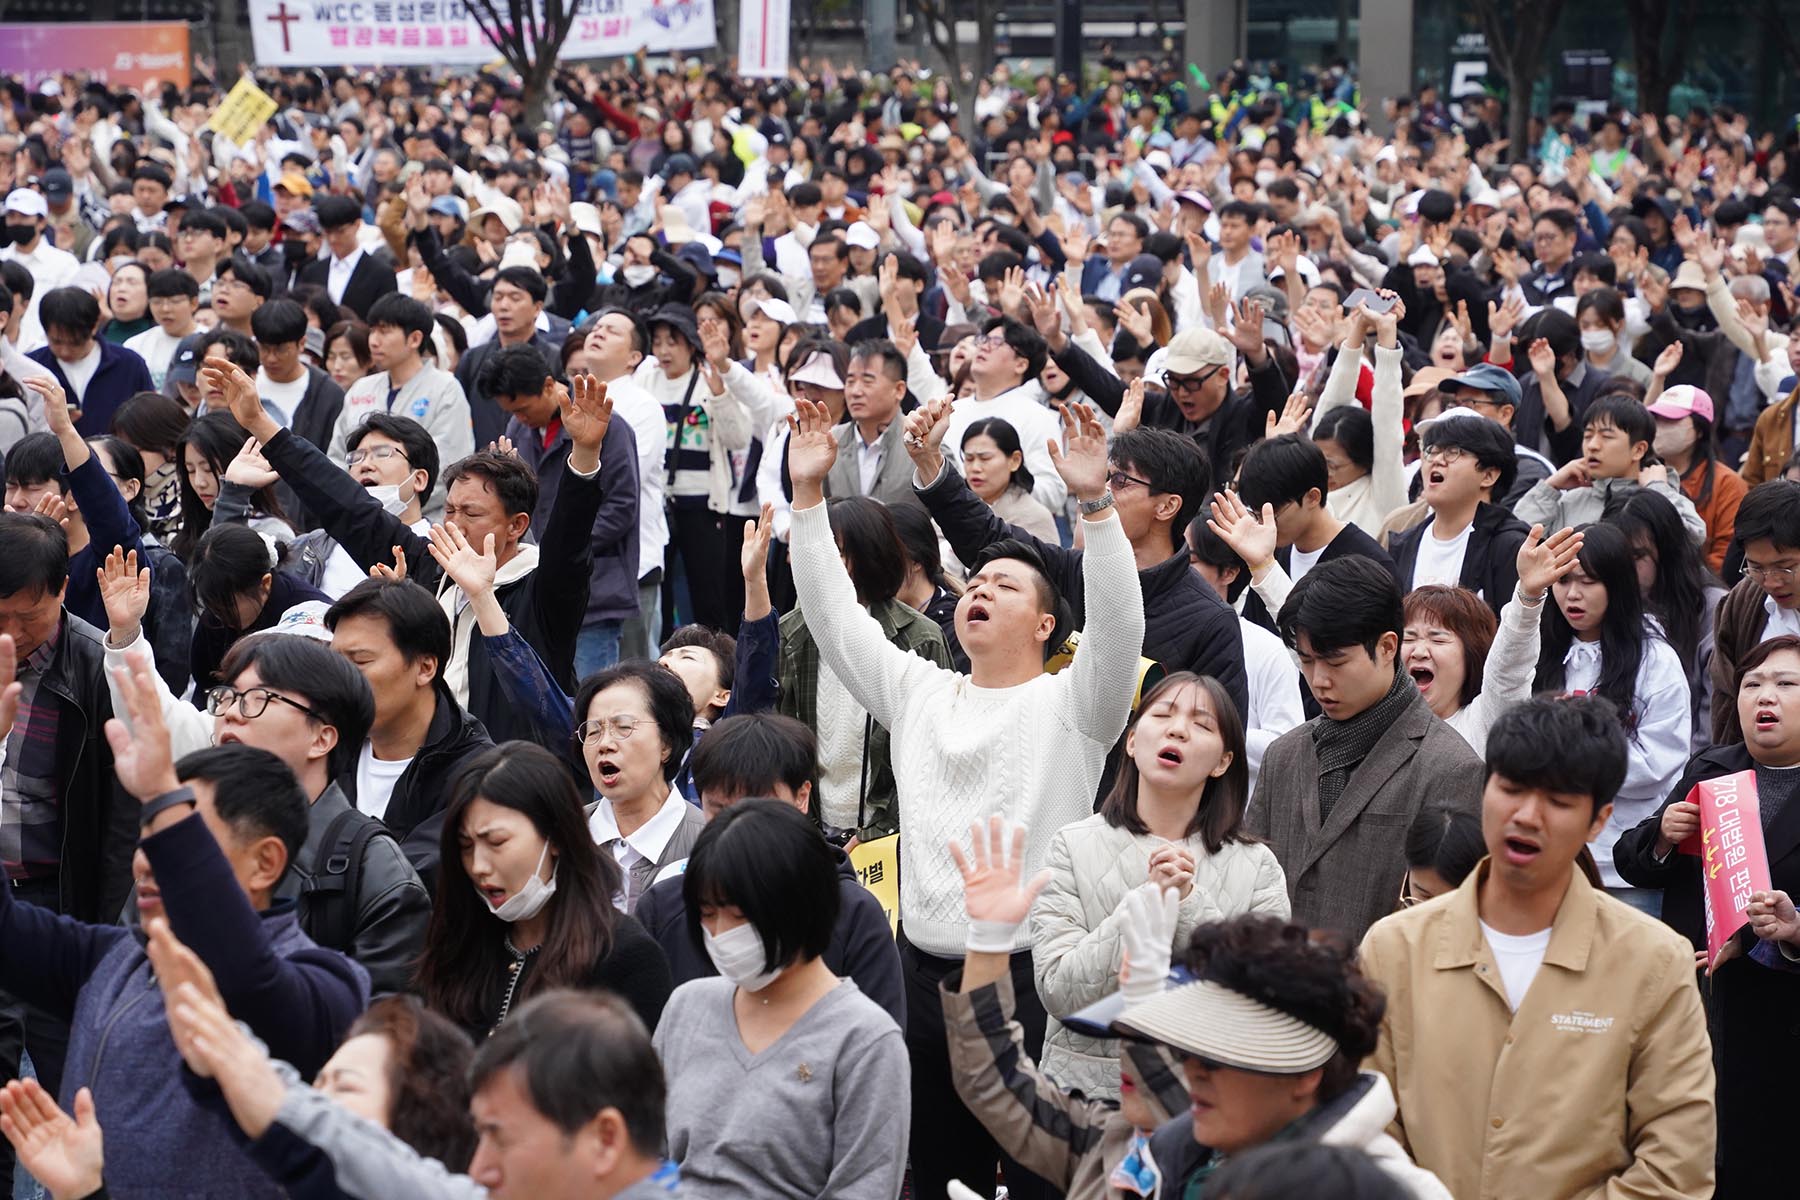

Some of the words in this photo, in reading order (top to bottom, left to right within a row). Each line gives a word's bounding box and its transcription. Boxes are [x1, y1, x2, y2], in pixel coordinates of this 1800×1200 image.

[1449, 61, 1489, 119] 5
[1719, 808, 1747, 870] 대법원
[1729, 867, 1753, 914] 판결
[1551, 1013, 1614, 1029] STATEMENT
